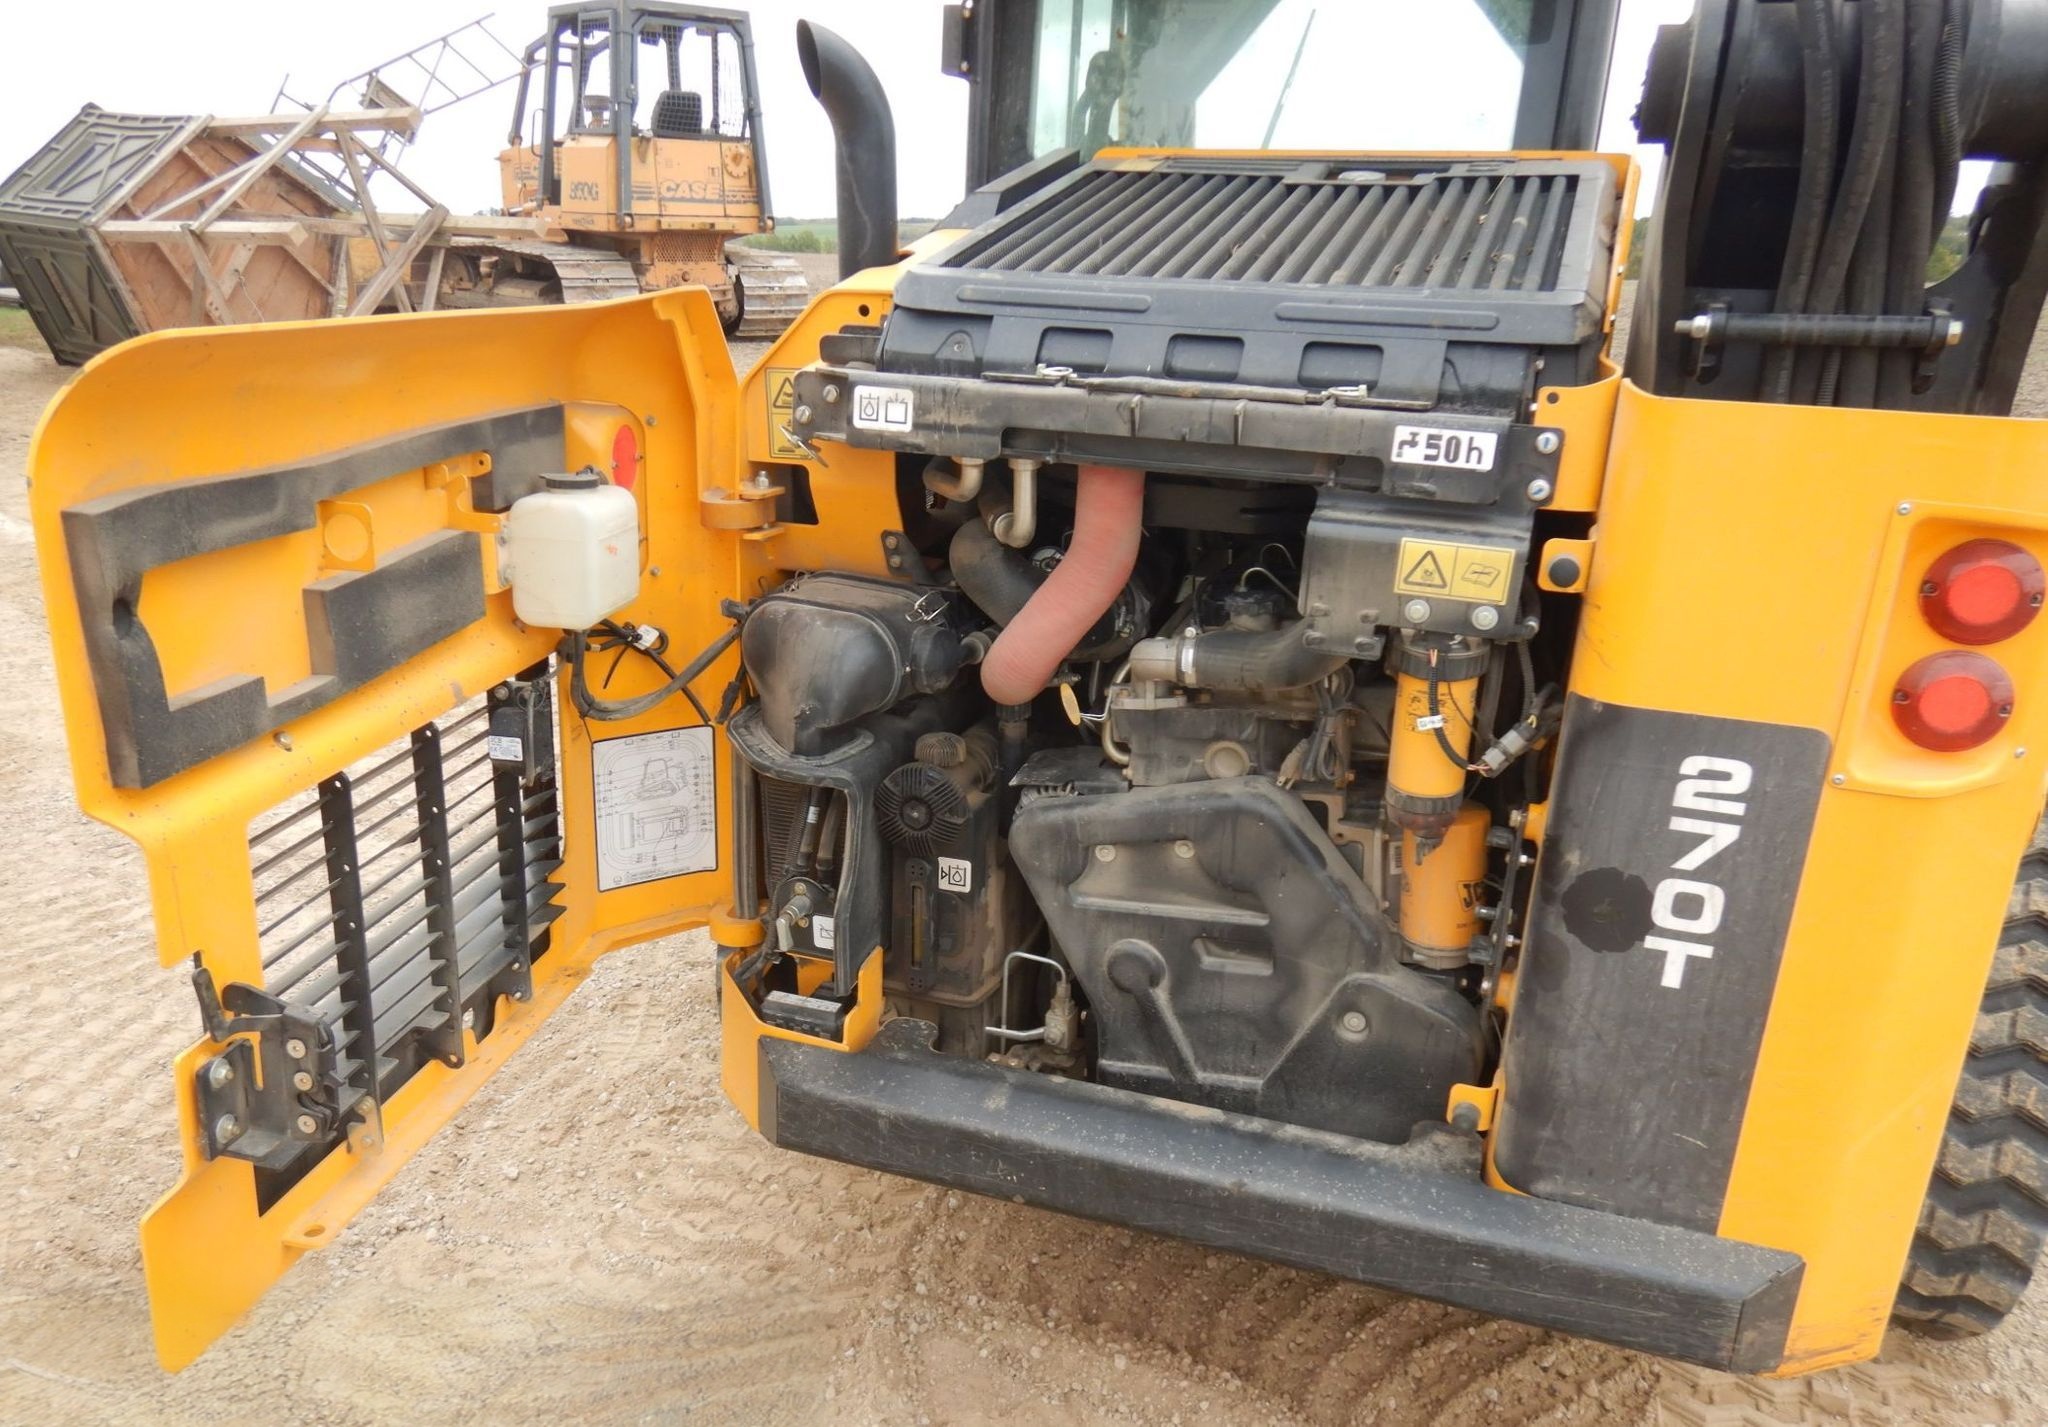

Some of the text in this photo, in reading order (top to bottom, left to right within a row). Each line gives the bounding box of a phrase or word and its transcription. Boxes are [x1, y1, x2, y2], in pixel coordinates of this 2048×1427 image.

[659, 179, 721, 199] CASE
[1644, 755, 1753, 990] 270T
[1463, 882, 1487, 908] JC
